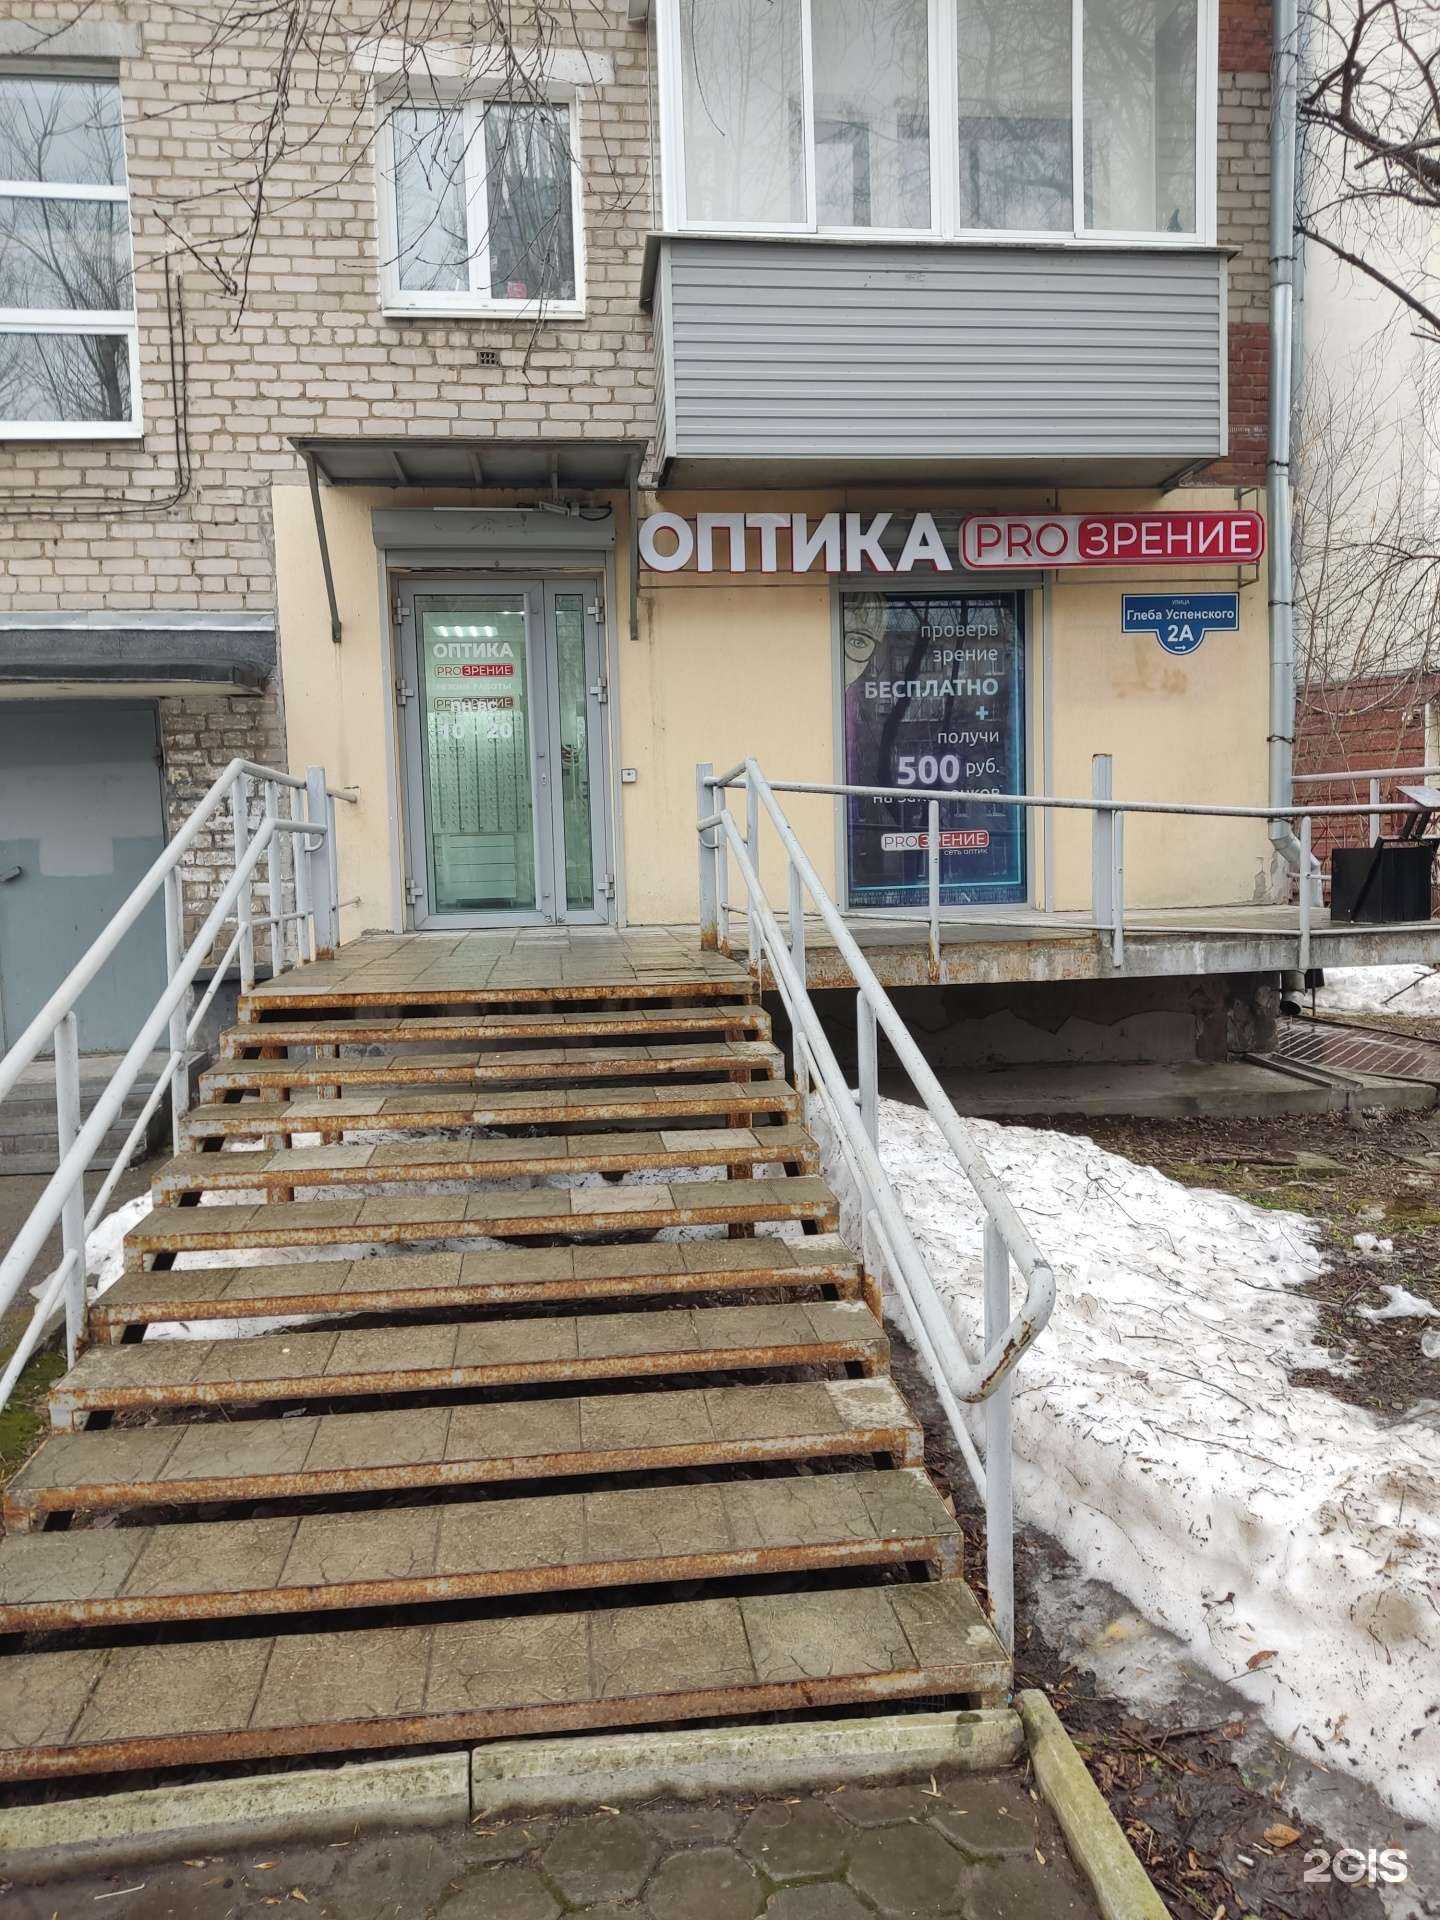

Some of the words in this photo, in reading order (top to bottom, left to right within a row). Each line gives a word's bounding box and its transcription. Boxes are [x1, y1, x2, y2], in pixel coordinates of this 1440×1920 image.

[638, 512, 953, 573] ОПТИКА
[975, 523, 1069, 560] PRO
[1085, 519, 1252, 556] ЗРЕНИЕ
[1127, 609, 1162, 620] Глеба
[1166, 608, 1234, 620] Успенского
[921, 623, 999, 640] проверь
[1167, 624, 1194, 642] 2А
[433, 642, 514, 658] ОПТИКА
[933, 646, 999, 663] зрение
[437, 666, 461, 676] PRO
[463, 665, 512, 676] ЗРЕНИЕ
[864, 678, 999, 699] БЕСПЛАТНО
[937, 730, 1000, 749] получи
[897, 754, 960, 785] 500
[966, 760, 1000, 777] руб.
[884, 835, 918, 849] PRO
[920, 832, 986, 848] ЗЕНИЕ
